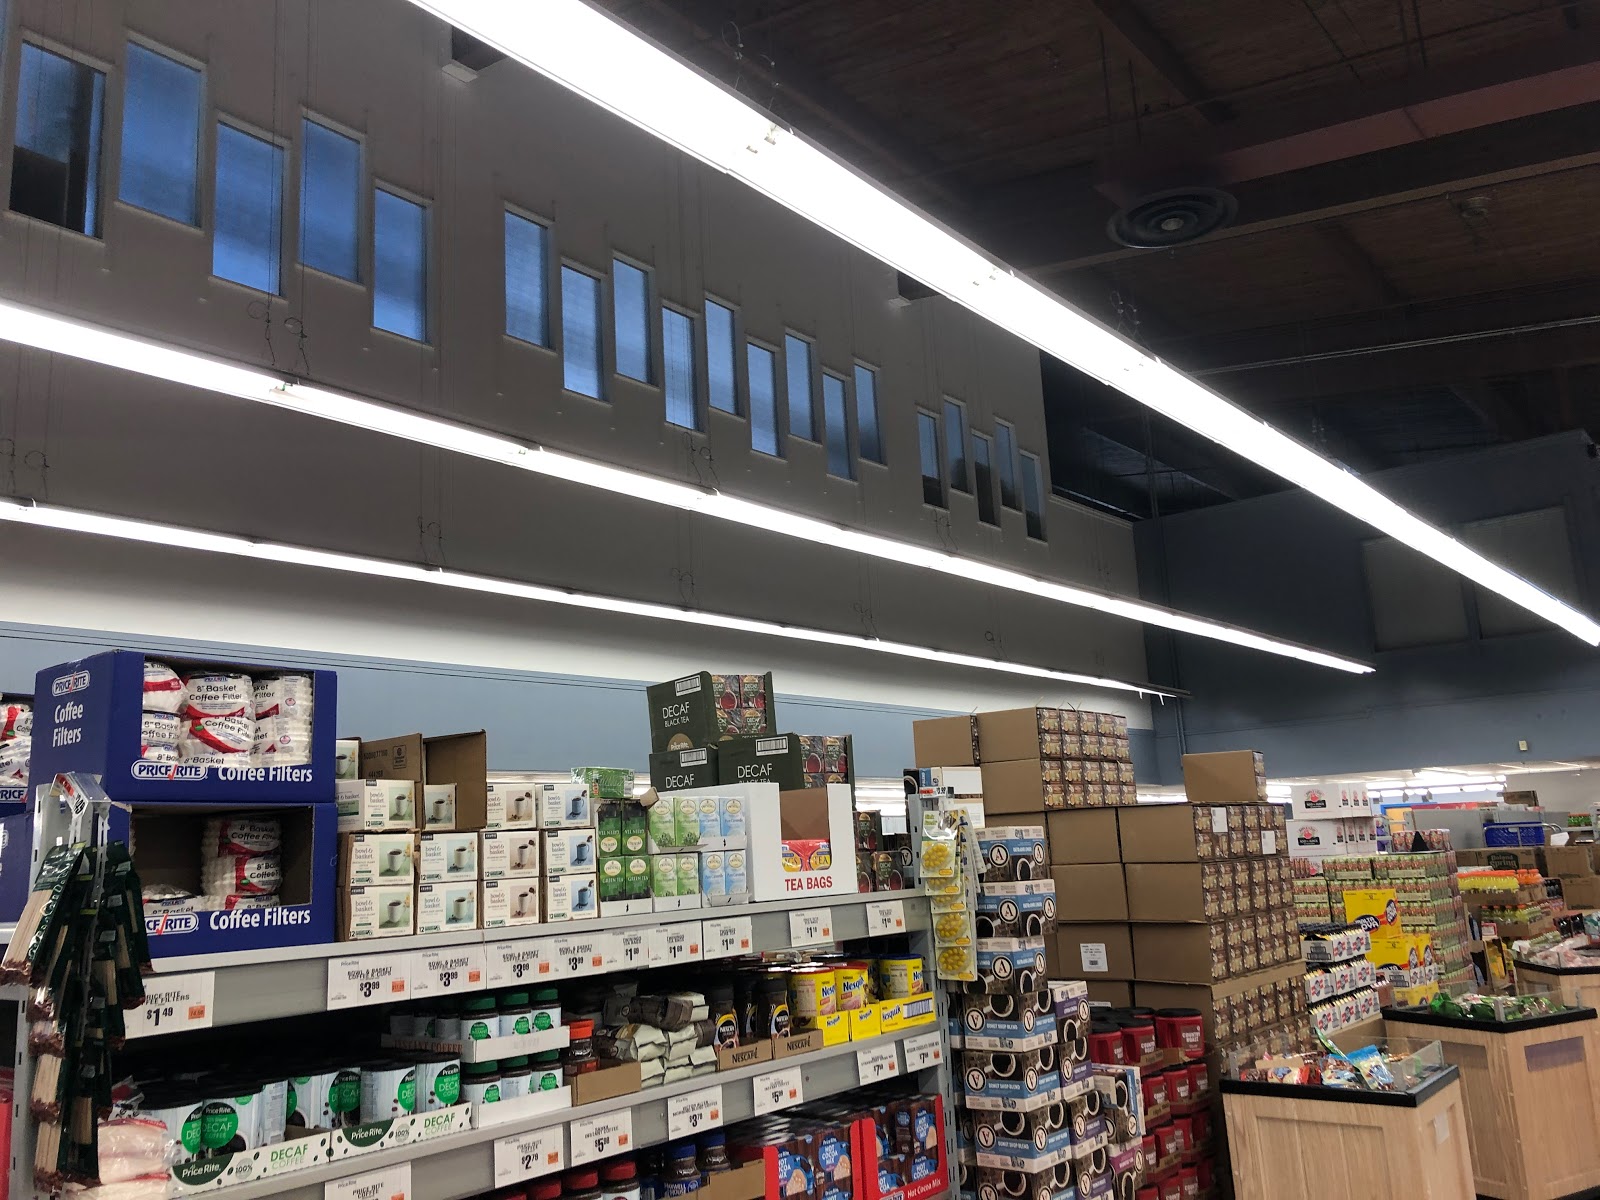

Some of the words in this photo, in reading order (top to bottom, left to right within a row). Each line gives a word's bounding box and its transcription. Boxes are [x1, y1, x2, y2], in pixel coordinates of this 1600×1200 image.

[55, 680, 72, 692] PRICE
[74, 676, 87, 689] RITE
[207, 684, 237, 693] Basket
[254, 684, 269, 692] sket
[189, 693, 220, 701] Coffee
[54, 701, 84, 724] Coffee
[662, 702, 691, 719] DECAF
[205, 720, 236, 732] Coffee
[664, 718, 682, 728] BLACK
[681, 717, 690, 725] TEA
[52, 727, 82, 748] Filters
[193, 757, 225, 765] Basket
[138, 765, 172, 776] PRICE
[175, 766, 201, 776] RITE
[269, 766, 313, 782] Filters
[737, 763, 773, 779] DECAF
[665, 773, 695, 789] DECAF
[231, 832, 260, 840] Coffee
[1490, 860, 1518, 869] Spring
[250, 871, 275, 879] Coffee
[785, 878, 804, 891] TEA
[806, 876, 833, 890] BAGS
[165, 917, 192, 930] RITE
[209, 909, 261, 930] Coffee
[263, 907, 312, 927] Filters
[438, 1080, 459, 1092] DECA
[402, 1089, 415, 1099] DEC
[424, 1113, 456, 1129] DECAF
[186, 1130, 201, 1140] DEC
[351, 1128, 369, 1140] Price
[425, 1123, 452, 1136] COFFEE
[270, 1144, 309, 1162] DECAF
[271, 1157, 305, 1170] COFFEE
[182, 1166, 203, 1179] Price
[203, 1163, 221, 1173] Rite
[907, 1188, 917, 1199] Hot
[917, 1184, 932, 1195] Cocoa
[932, 1179, 941, 1188] Mix
